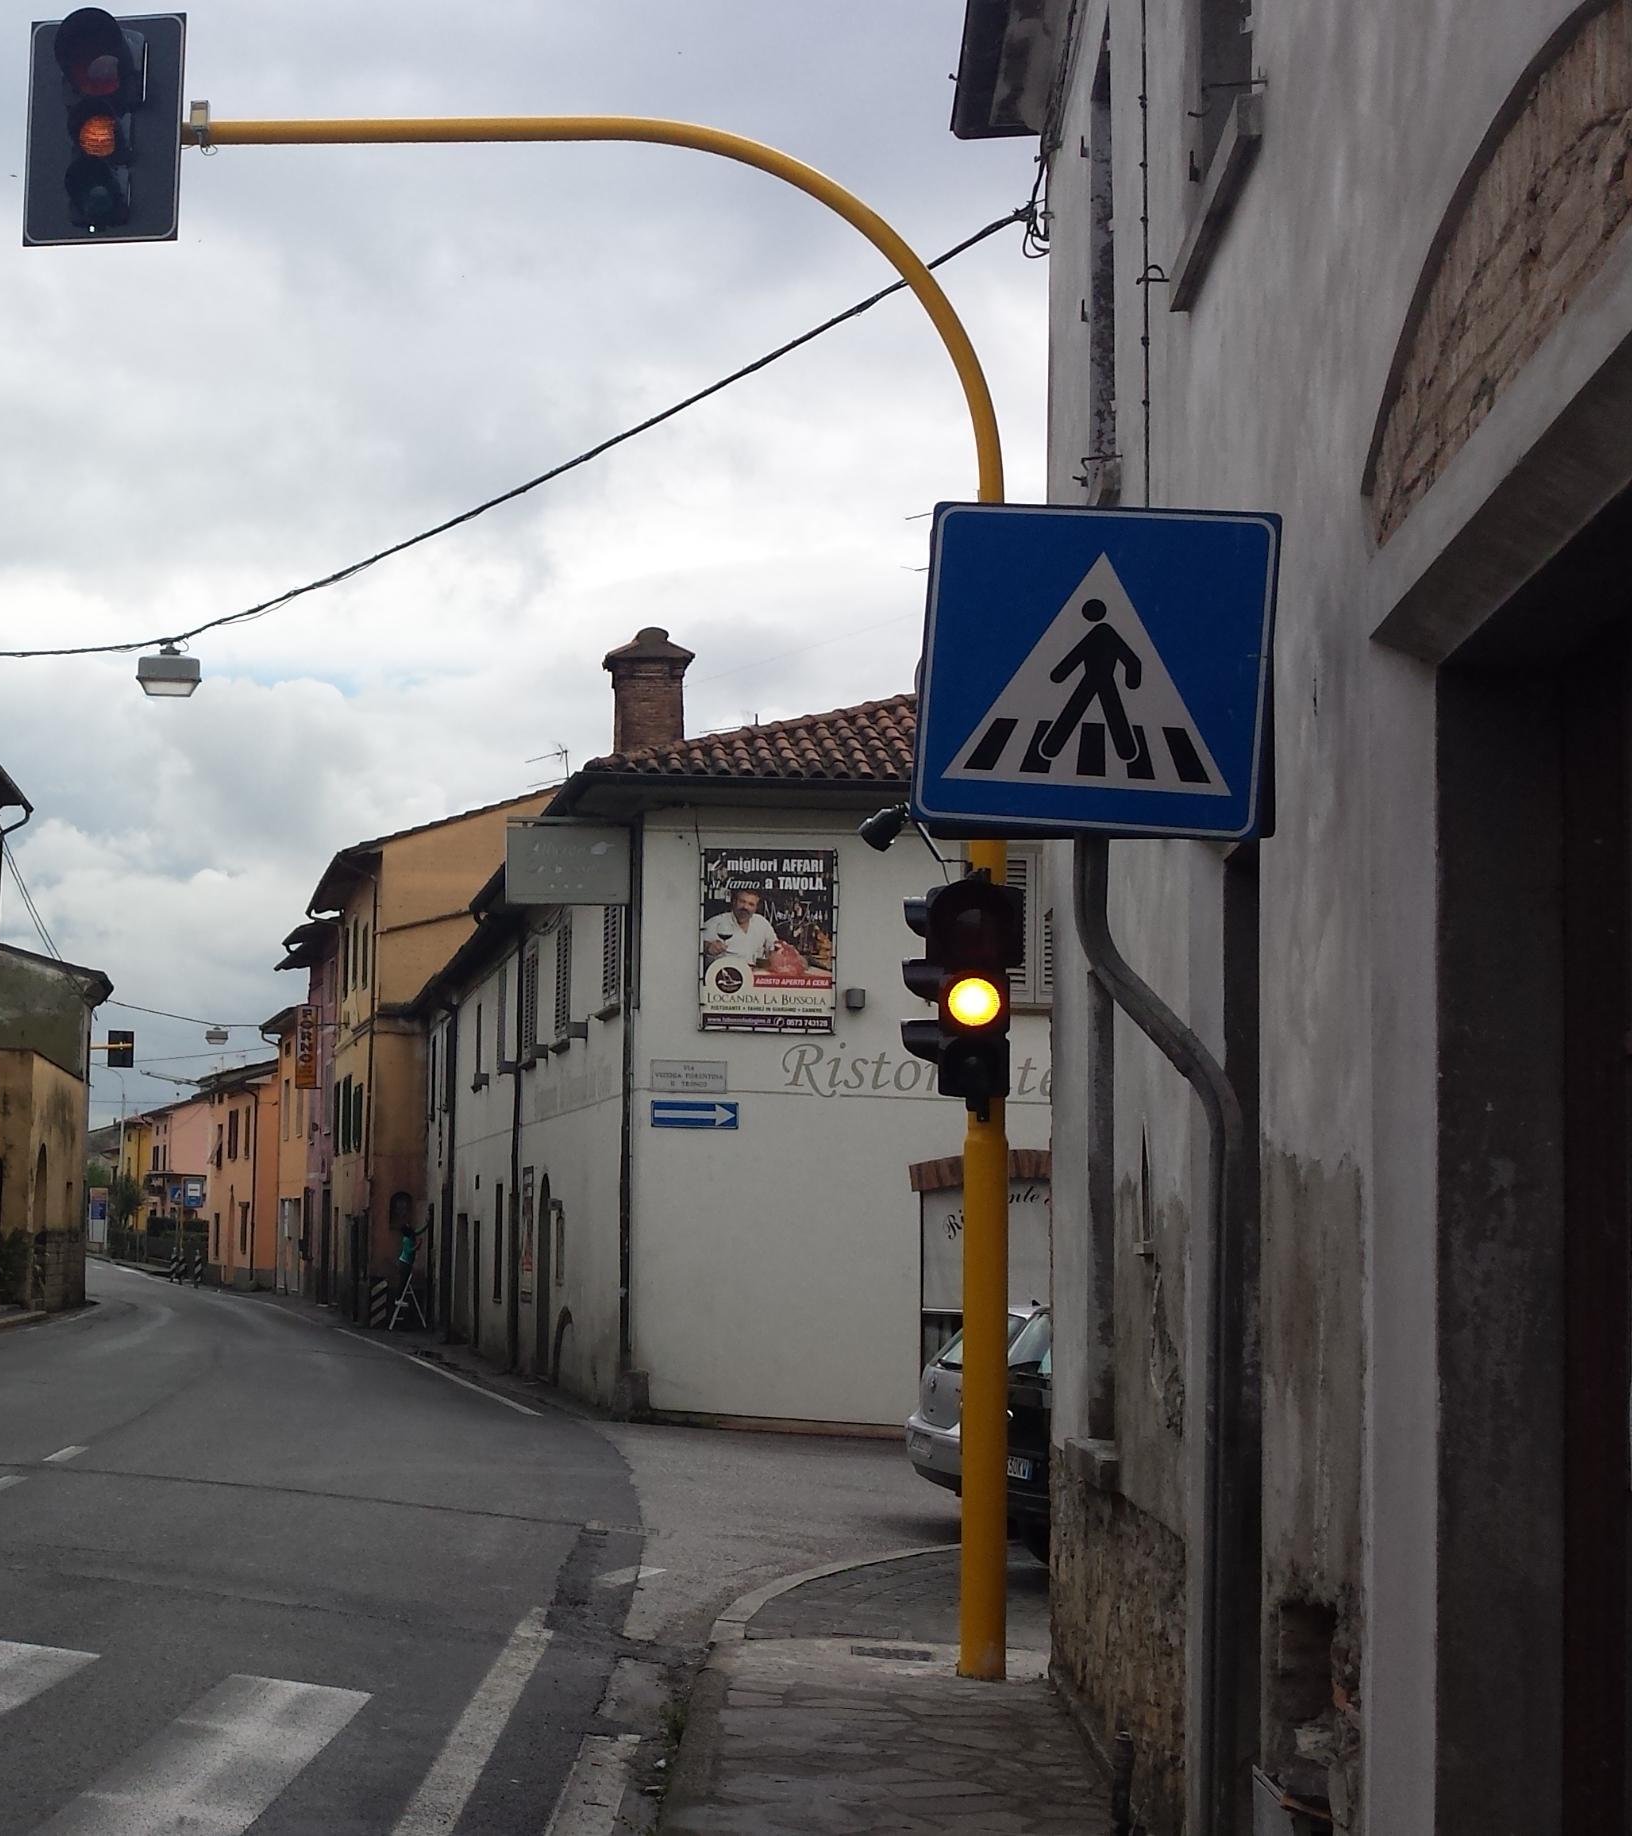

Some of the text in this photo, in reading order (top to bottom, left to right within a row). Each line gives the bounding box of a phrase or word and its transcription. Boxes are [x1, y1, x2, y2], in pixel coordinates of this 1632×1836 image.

[727, 857, 777, 872] migliori
[782, 859, 824, 873] AFFARI
[724, 876, 761, 889] fanno
[764, 878, 773, 890] a
[777, 876, 827, 891] TAVOLA.
[755, 977, 780, 985] AGOSTO
[781, 978, 805, 986] APERTO
[812, 979, 829, 987] CENA
[707, 993, 759, 1004] LOCANDA
[781, 994, 827, 1006] BUSSOLA
[299, 1008, 313, 1063] FORNO
[782, 1042, 1052, 1098] Ristorte
